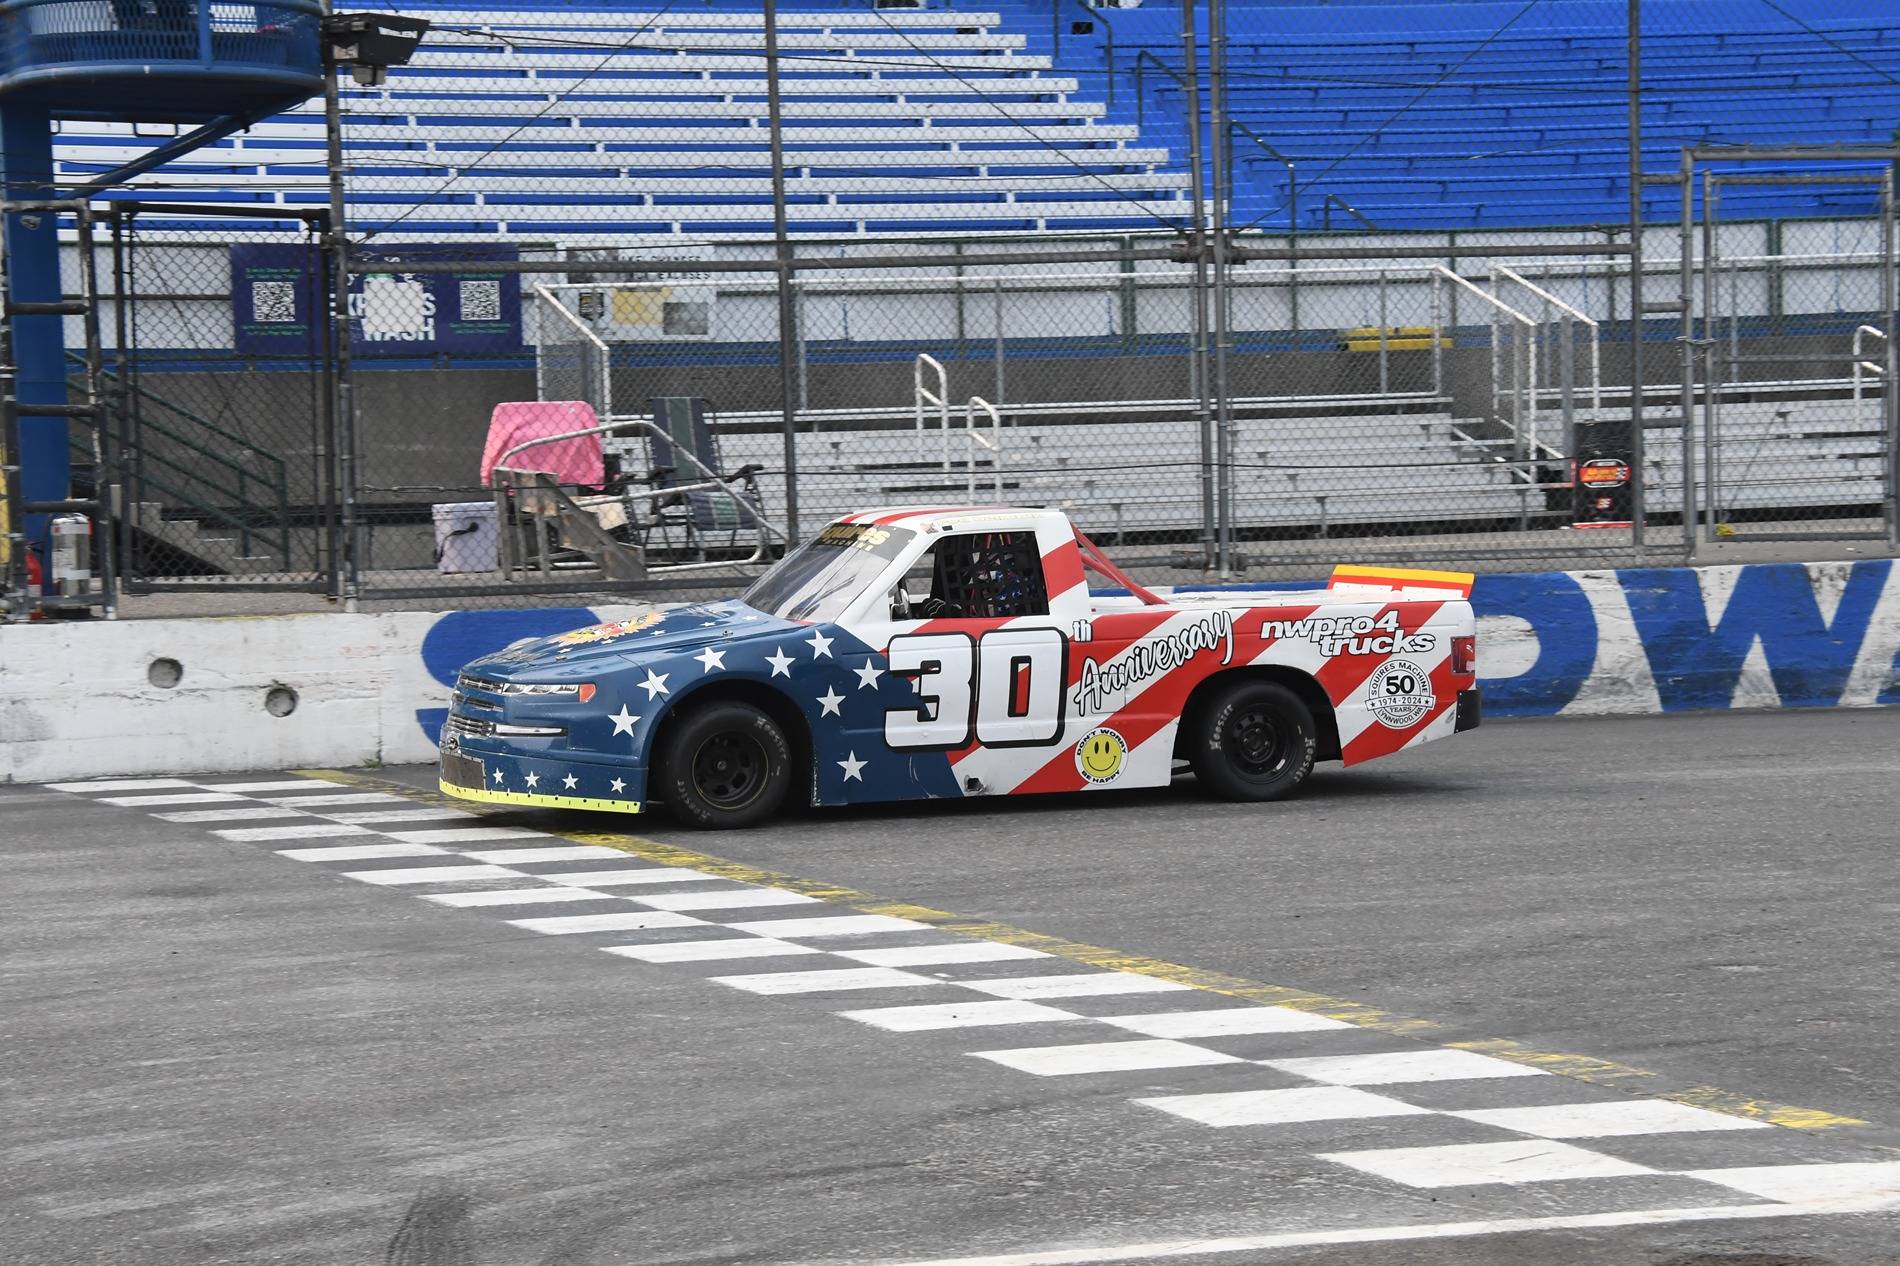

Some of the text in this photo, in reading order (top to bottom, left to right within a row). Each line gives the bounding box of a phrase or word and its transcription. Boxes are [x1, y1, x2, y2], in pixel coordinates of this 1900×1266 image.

[1260, 610, 1399, 643] nwpro4
[1318, 629, 1436, 657] trucks
[884, 611, 1234, 751] 30 th Anniversary
[1371, 662, 1428, 696] SQUIRES MACHINE
[1385, 675, 1415, 695] 50
[1377, 709, 1415, 725] LYNNWOOD
[1077, 729, 1127, 756] DON'T WORRY
[1081, 769, 1120, 783] BE HAPPY
